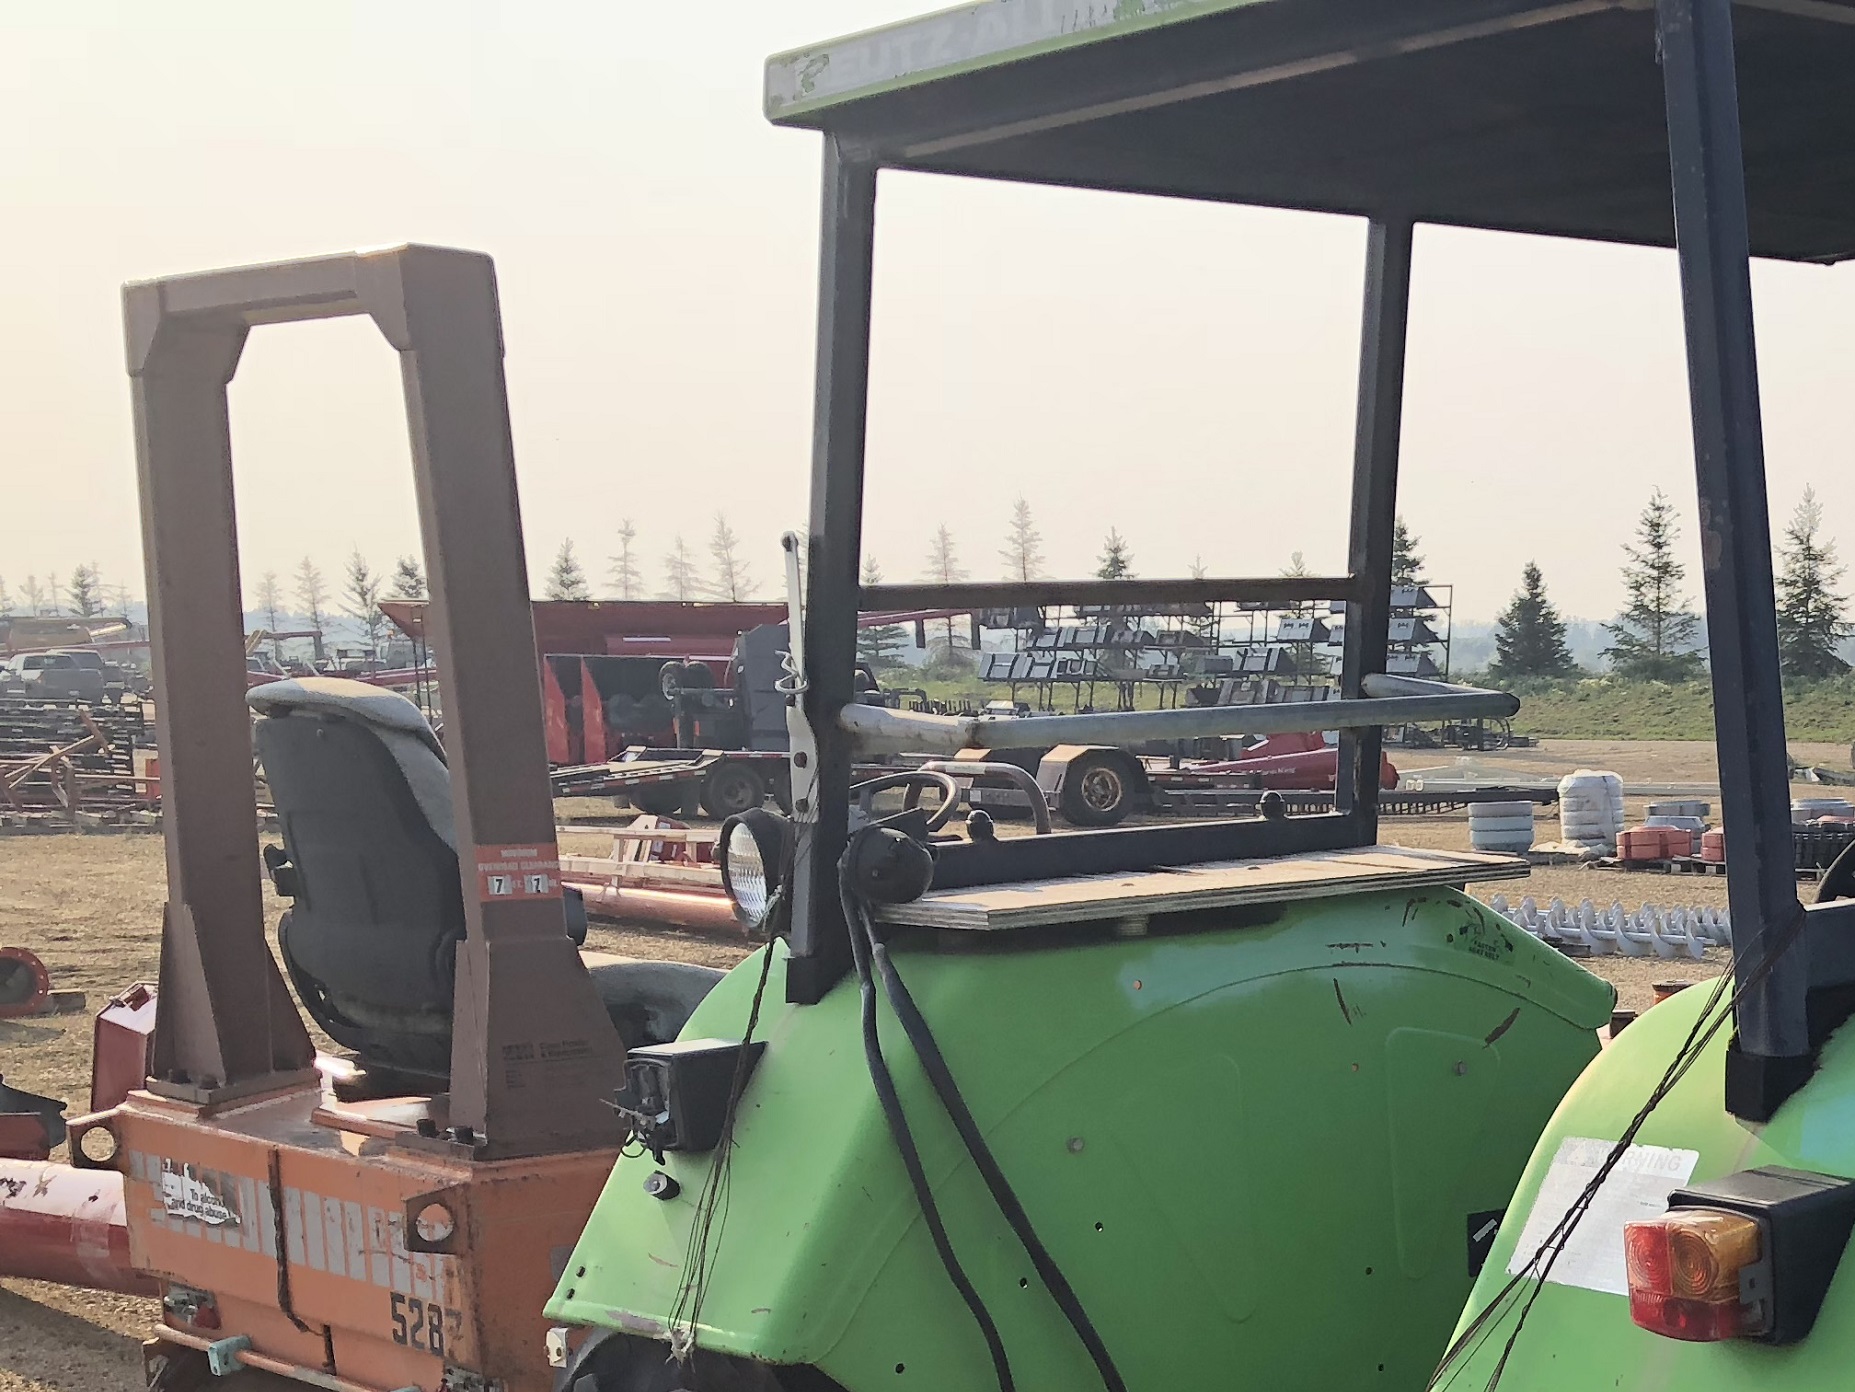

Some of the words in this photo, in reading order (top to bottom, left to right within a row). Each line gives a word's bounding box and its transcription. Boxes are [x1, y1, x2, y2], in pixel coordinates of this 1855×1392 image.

[495, 878, 503, 893] 7
[187, 1201, 204, 1216] drug
[205, 1206, 228, 1220] abuse
